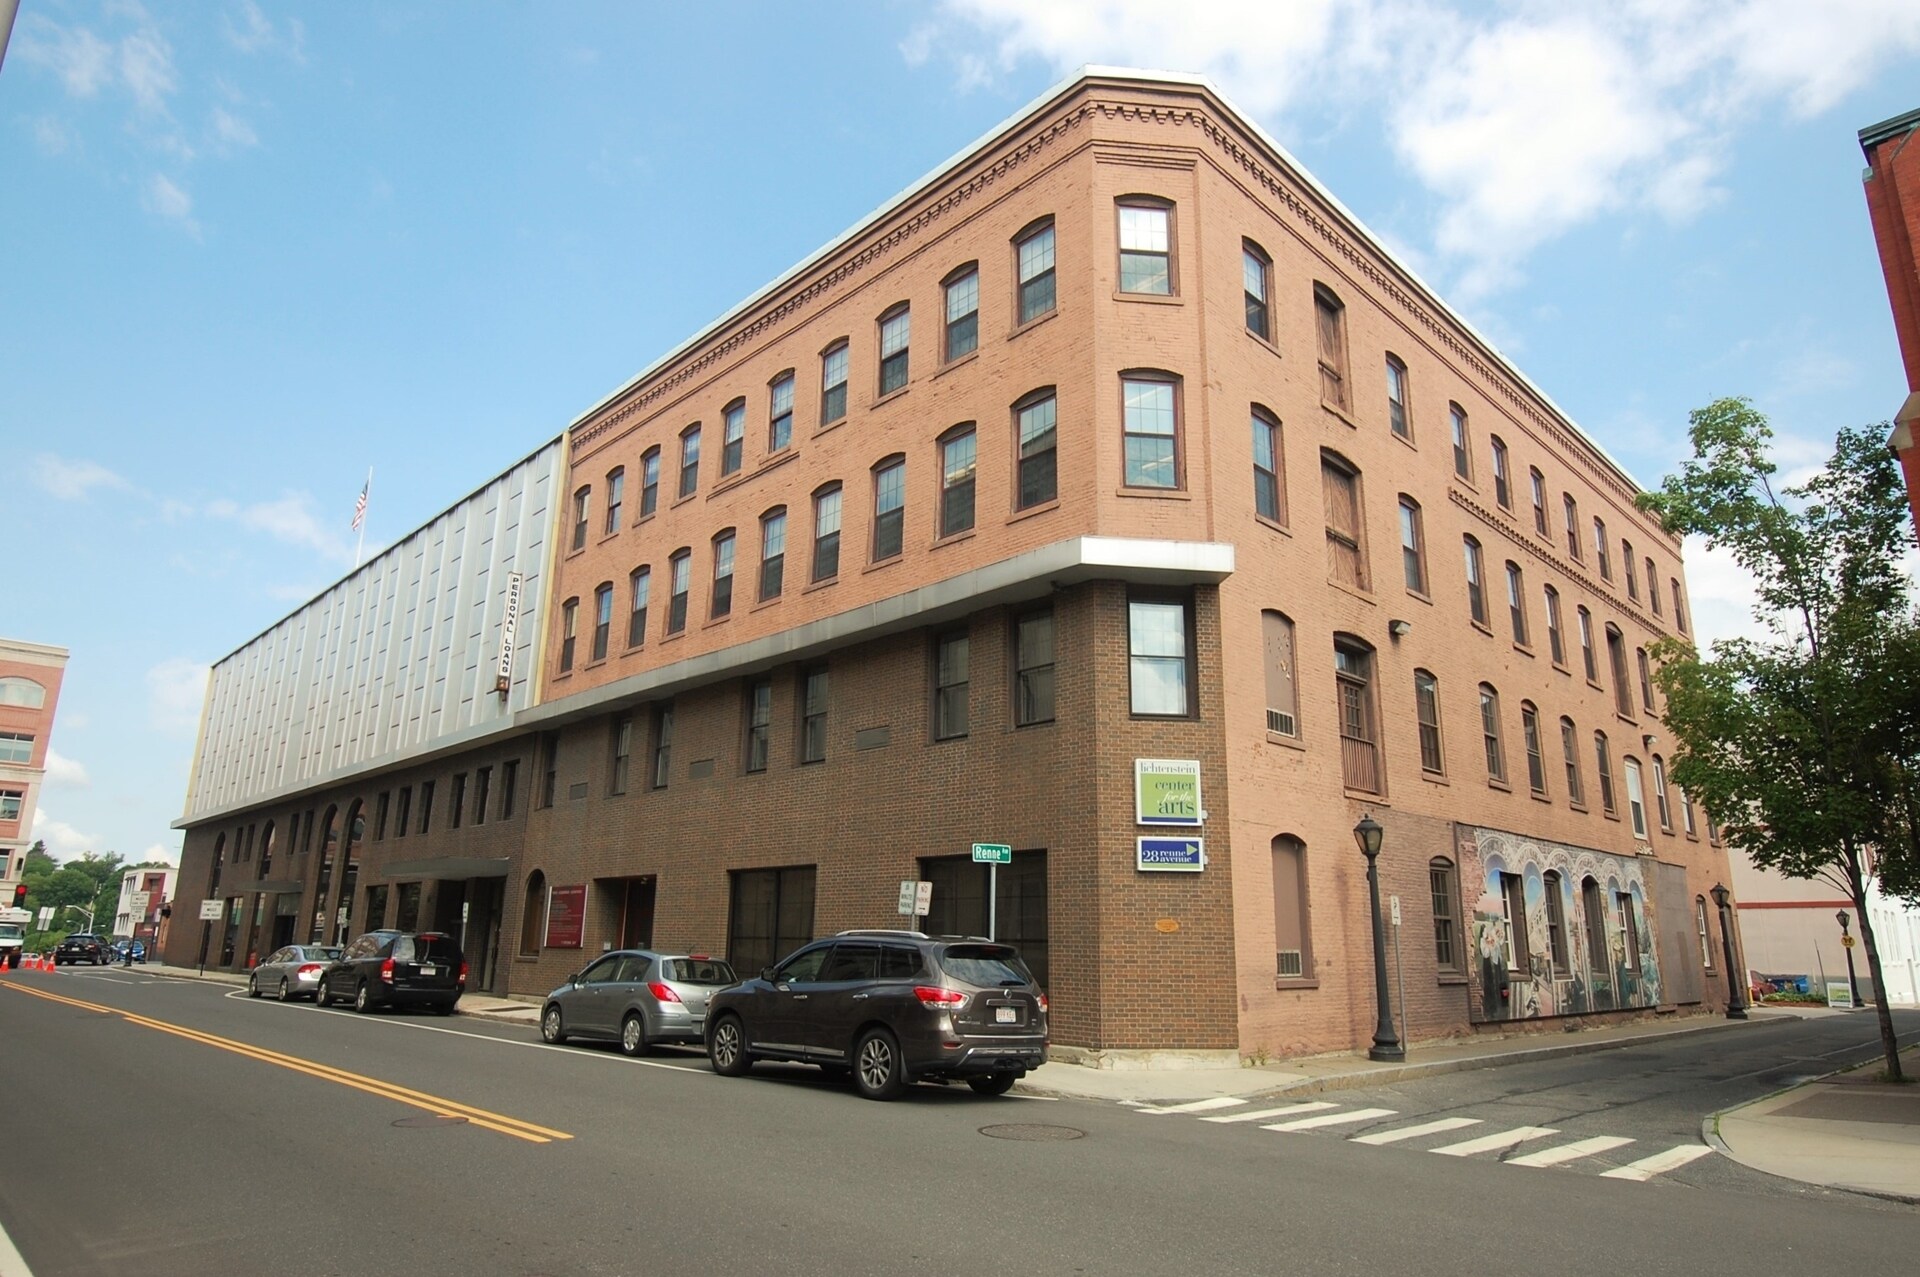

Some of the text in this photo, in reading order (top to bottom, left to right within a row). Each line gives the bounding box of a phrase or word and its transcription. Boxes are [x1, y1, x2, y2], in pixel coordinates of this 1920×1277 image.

[502, 577, 519, 673] PERSONAL LOANS
[1141, 762, 1195, 773] lichtenstein
[1155, 781, 1195, 790] center
[1158, 791, 1194, 804] for the
[1158, 801, 1195, 815] arts
[976, 847, 1001, 860] Renne
[1142, 849, 1160, 863] 28
